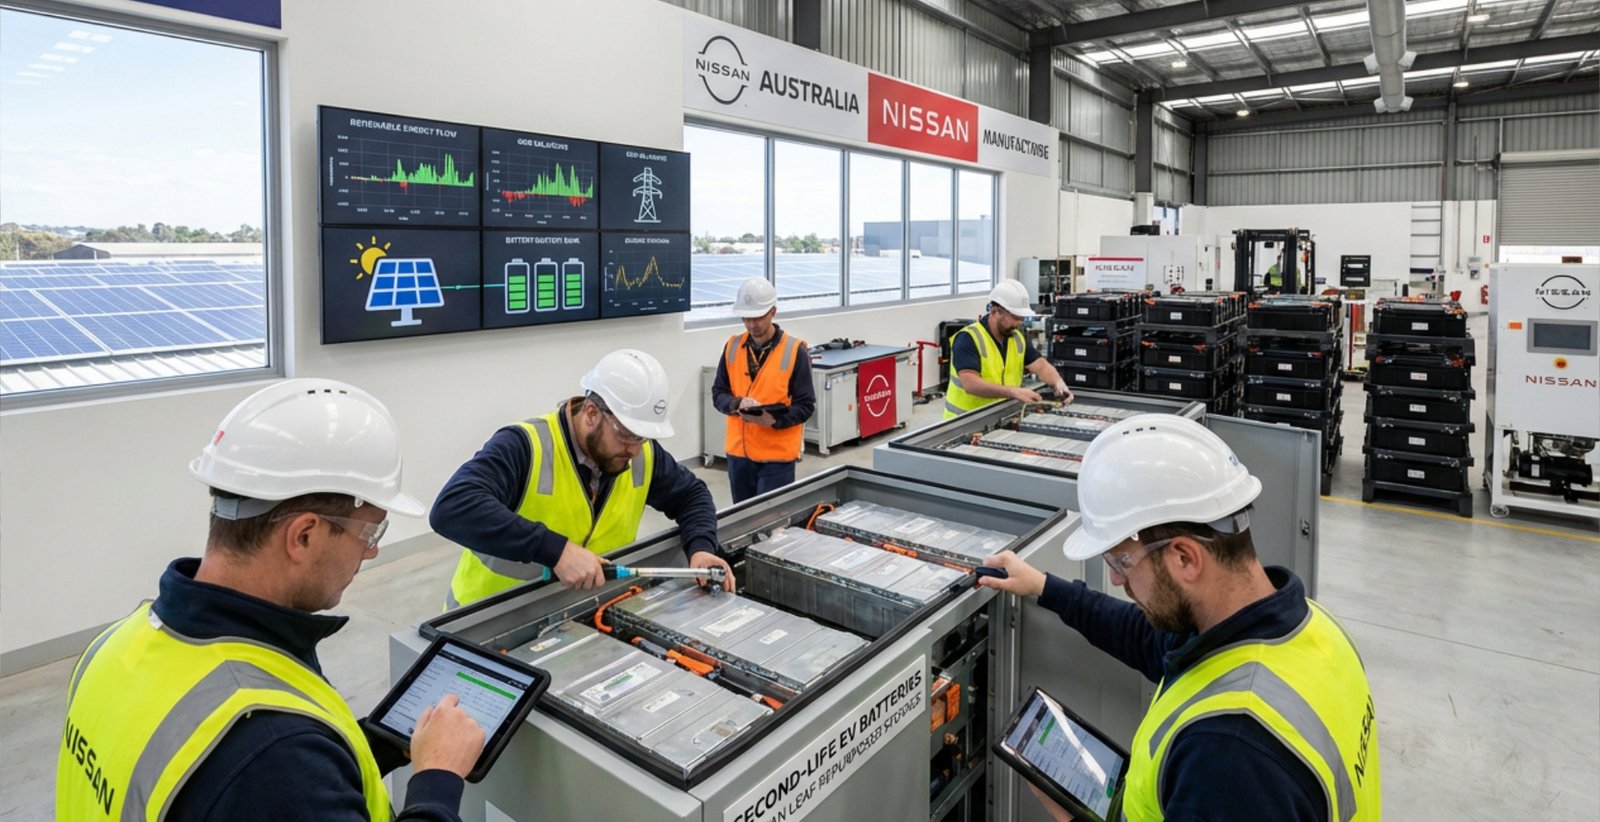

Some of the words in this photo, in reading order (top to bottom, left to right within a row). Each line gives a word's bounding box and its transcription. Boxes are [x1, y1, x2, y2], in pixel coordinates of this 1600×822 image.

[696, 58, 750, 81] NISSAN
[759, 70, 860, 114] AUSTRALIA
[882, 98, 969, 143] NISSAN
[1526, 375, 1597, 388] NISSAN
[840, 722, 857, 749] EV
[860, 670, 922, 733] BATTERIES
[789, 781, 816, 815] LEAF
